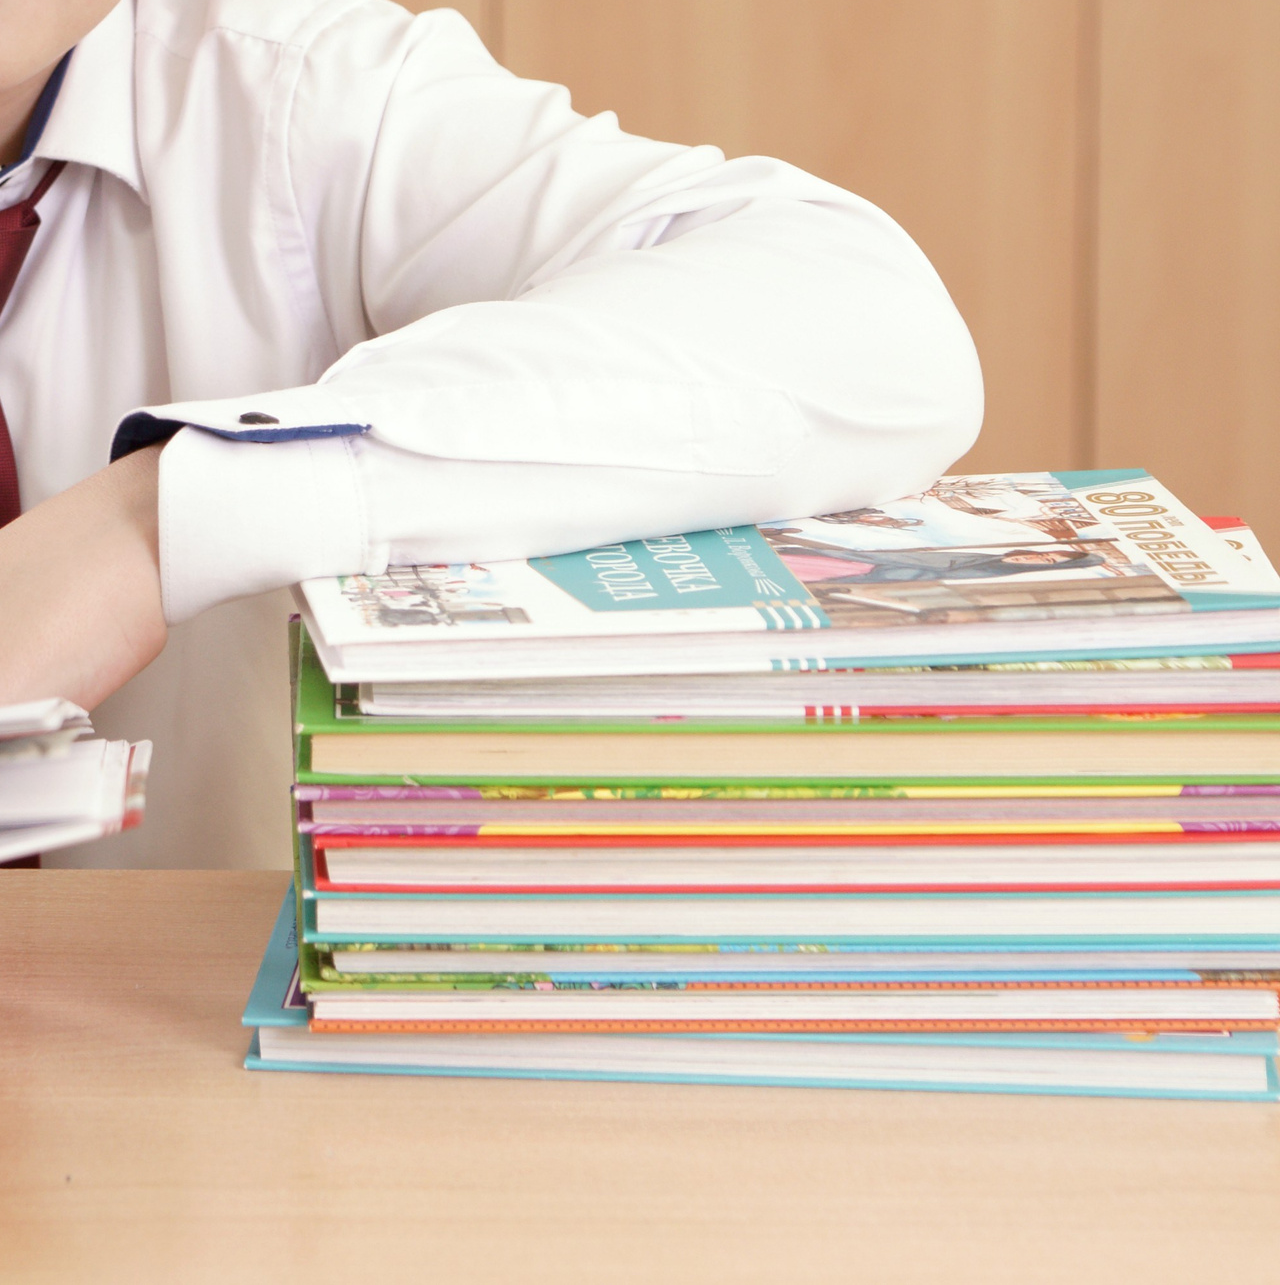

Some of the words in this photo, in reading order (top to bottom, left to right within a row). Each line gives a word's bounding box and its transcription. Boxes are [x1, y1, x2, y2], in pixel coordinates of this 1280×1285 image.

[1085, 491, 1169, 517] 80
[641, 535, 723, 594] ЕВОЧКА
[1111, 519, 1230, 587] ПОБЕДЫ
